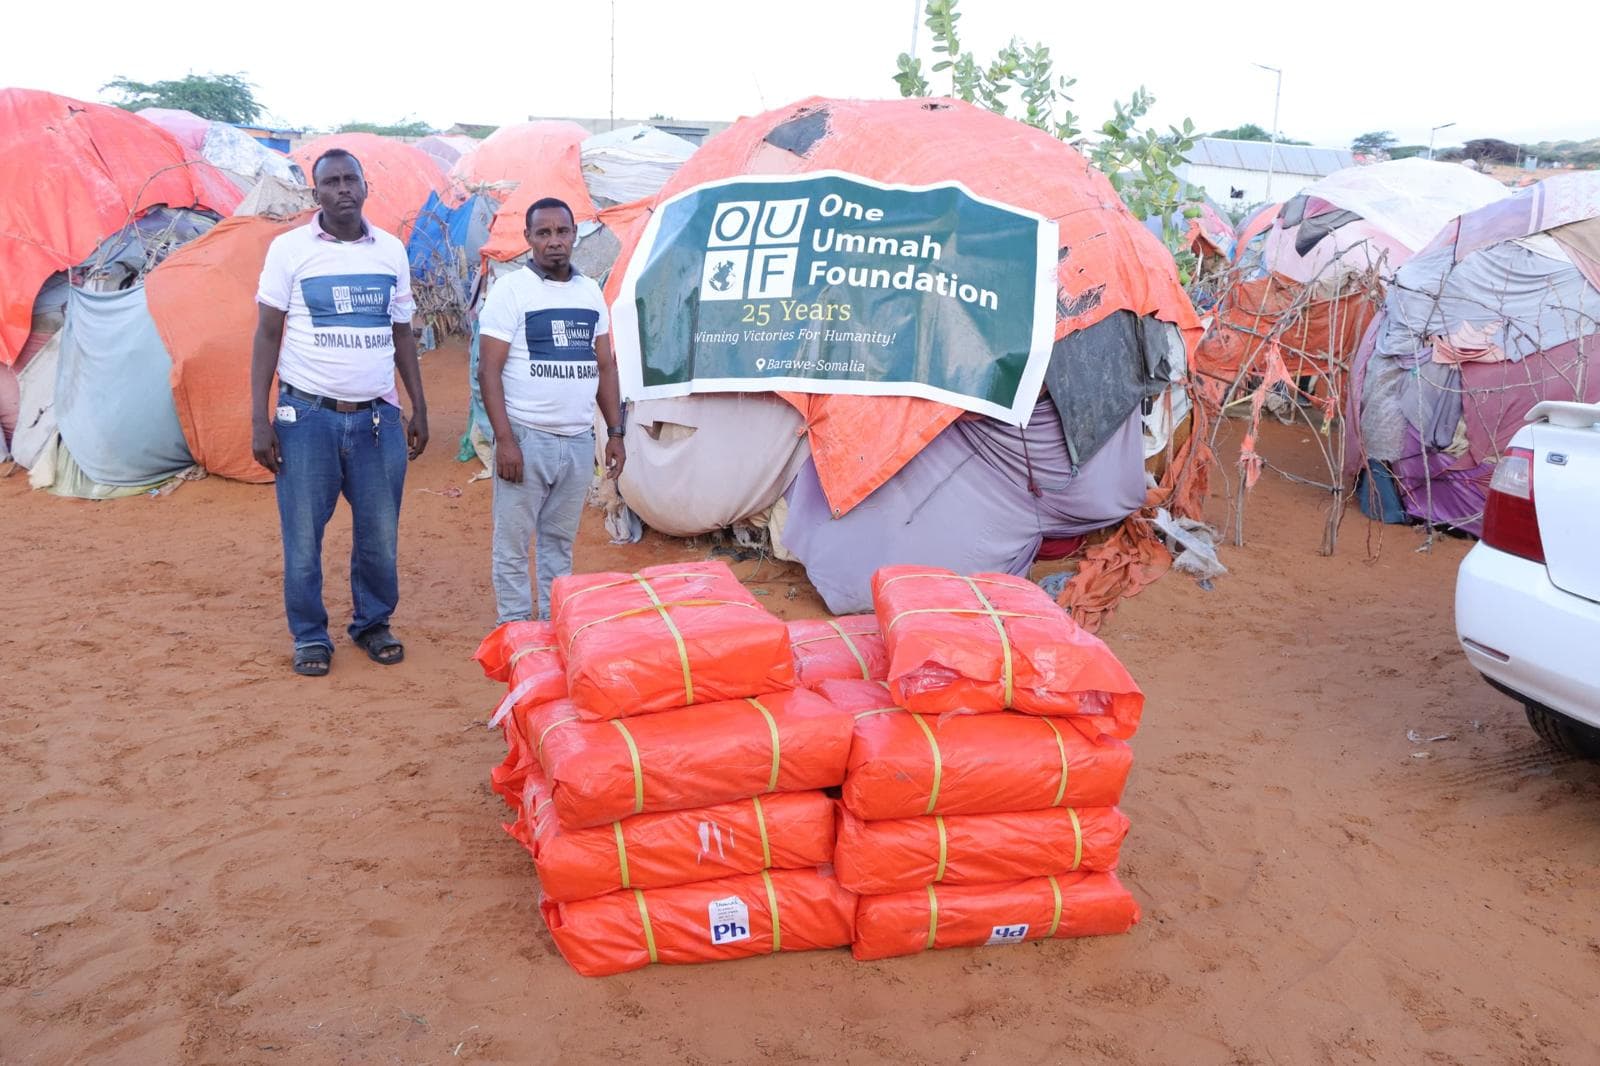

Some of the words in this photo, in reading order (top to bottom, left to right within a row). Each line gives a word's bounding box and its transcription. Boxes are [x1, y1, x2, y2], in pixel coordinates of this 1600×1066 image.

[818, 193, 885, 222] One
[811, 227, 942, 261] Ummah
[807, 260, 999, 311] Foundation
[351, 293, 383, 305] UMMAH
[741, 303, 771, 327] 25
[779, 299, 852, 322] Years
[314, 333, 363, 350] SOMALIA
[565, 329, 590, 339] UMMAH
[743, 328, 796, 343] Victories
[797, 328, 820, 341] For
[823, 329, 897, 347] Humanity!
[530, 363, 576, 379] SOMALIA
[766, 358, 866, 373] Barawe-Somalia
[713, 922, 746, 941] Ph
